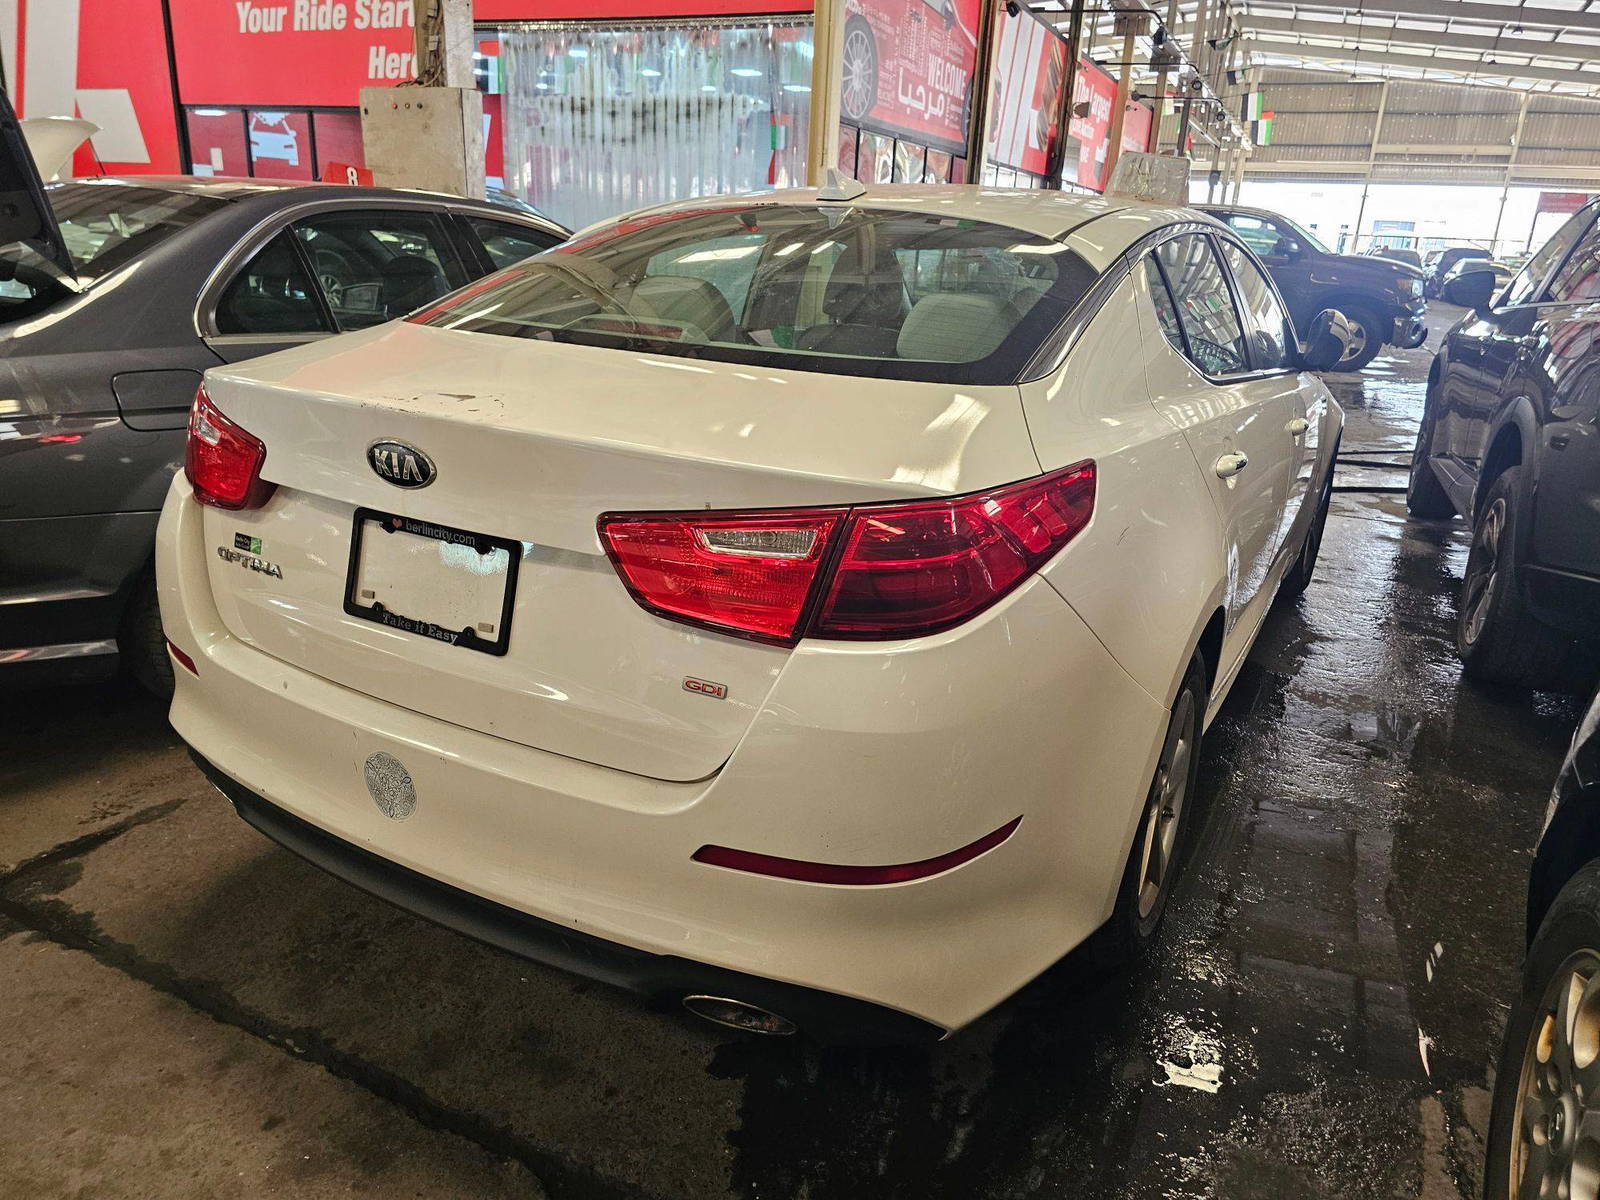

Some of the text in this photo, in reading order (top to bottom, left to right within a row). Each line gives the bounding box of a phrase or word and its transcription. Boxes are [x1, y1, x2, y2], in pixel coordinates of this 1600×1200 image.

[236, 2, 288, 33] Your
[293, 0, 348, 31] Ride
[927, 53, 967, 100] WELCOME
[898, 67, 945, 120] مرحبا
[374, 448, 423, 482] KIA
[405, 519, 476, 546] berlincity.com
[217, 546, 283, 580] OPTIMA
[383, 613, 458, 645] Take it Easy
[685, 680, 723, 697] GDI
